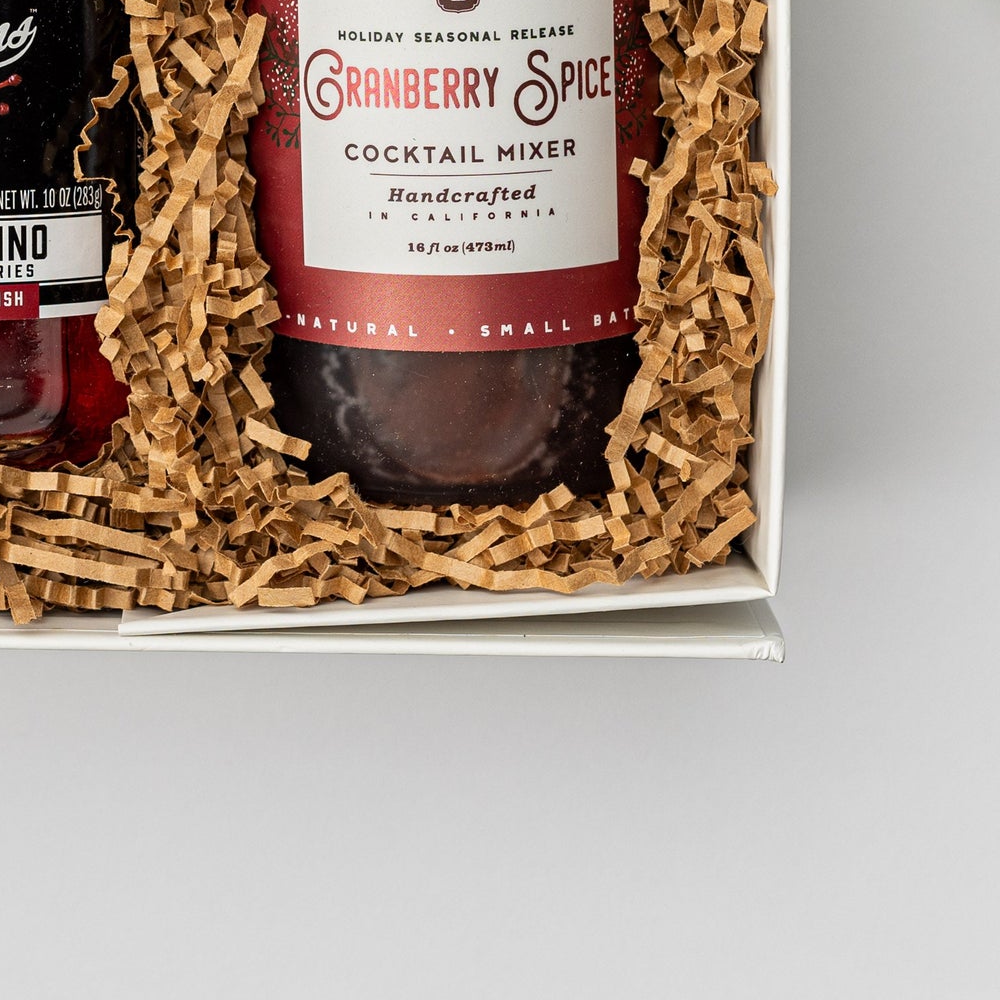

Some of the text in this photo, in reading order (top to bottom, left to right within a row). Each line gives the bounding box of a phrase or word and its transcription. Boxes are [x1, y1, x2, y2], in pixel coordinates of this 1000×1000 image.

[338, 25, 575, 43] HOLIDAY SEASONAL RELEASE
[303, 48, 612, 126] CRANBERRY SPICE
[344, 138, 576, 164] COCKTAIL MIXER
[20, 189, 39, 209] WT.
[43, 188, 56, 208] 10
[58, 187, 72, 207] OZ
[73, 183, 103, 210] (283g)
[387, 184, 537, 206] Handcrafted
[368, 207, 556, 222] IN CALIFORNIA
[407, 240, 516, 256] 16 fl oz (473ml)
[480, 318, 571, 338] SMALL
